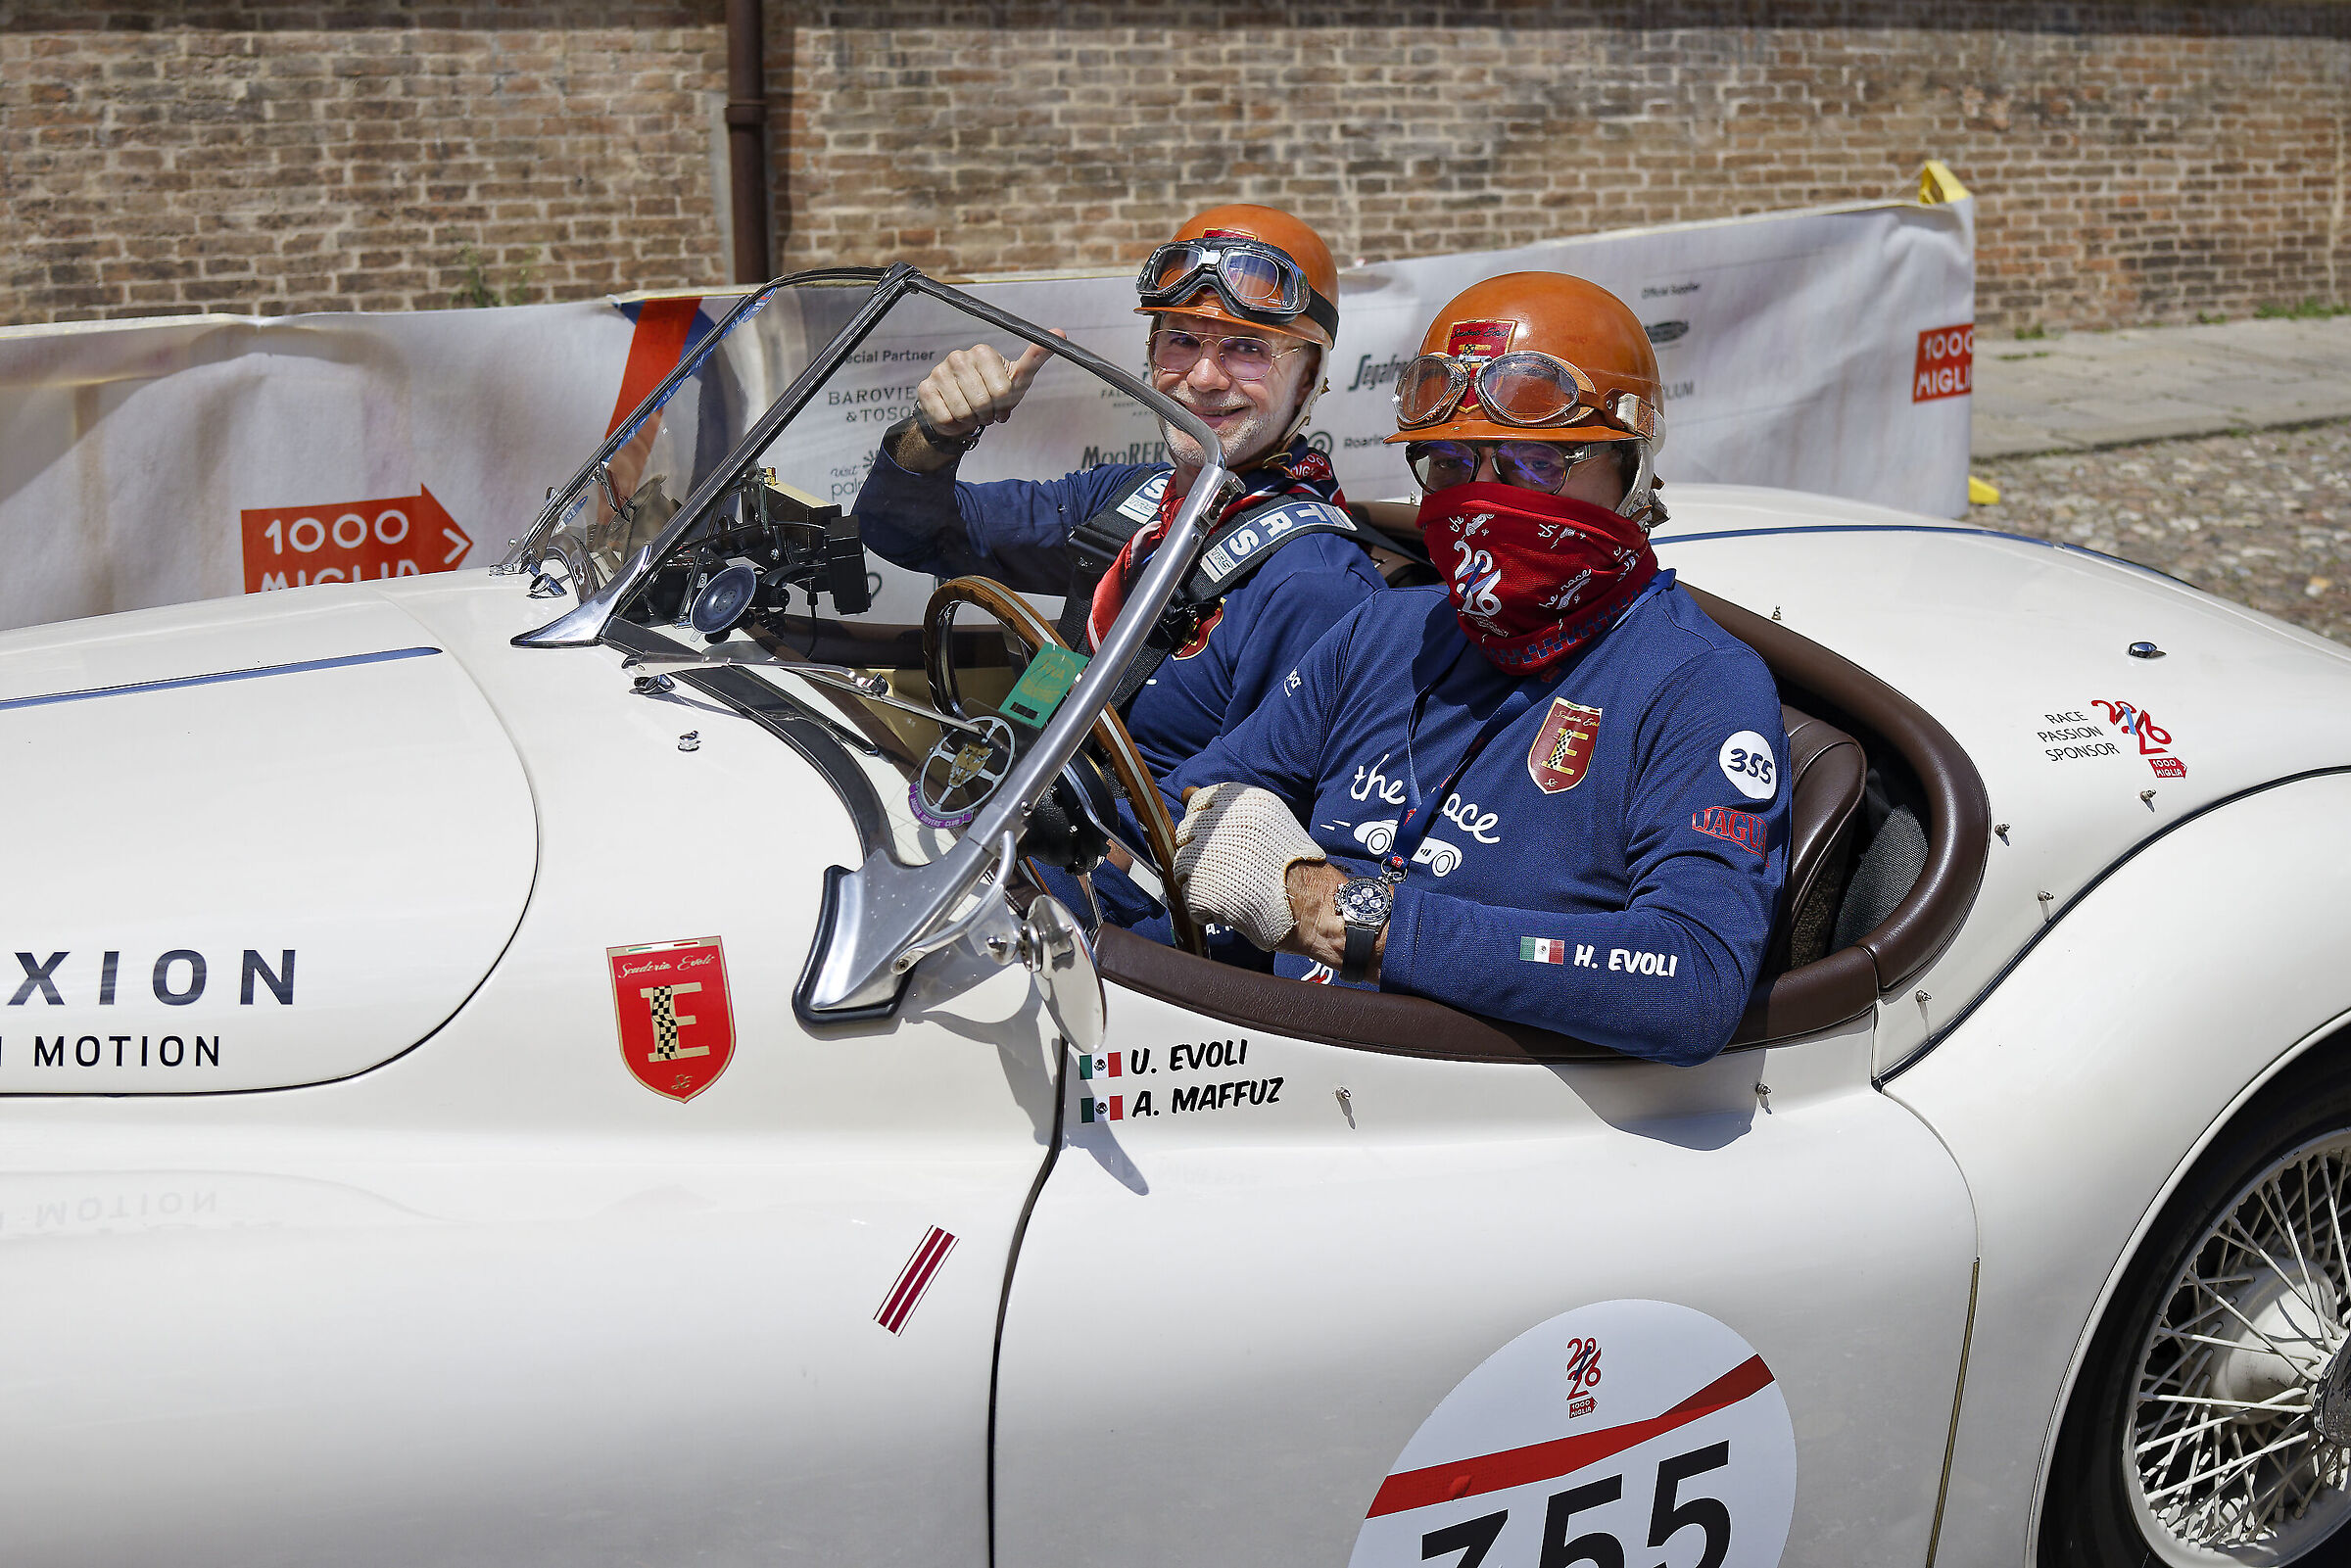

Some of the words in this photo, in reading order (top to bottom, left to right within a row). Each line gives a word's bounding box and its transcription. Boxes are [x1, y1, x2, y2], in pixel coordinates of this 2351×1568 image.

[845, 351, 878, 364] ecial
[882, 350, 936, 362] Partner
[1916, 365, 1972, 397] MIGLI
[828, 386, 918, 405] BAROVIE
[831, 477, 864, 501] pal
[264, 509, 409, 555] 1000
[2044, 711, 2089, 725] RACE
[2037, 726, 2104, 743] PASSION
[2045, 742, 2121, 762] SPONSOR
[2152, 759, 2177, 768] 1000
[1727, 748, 1773, 784] 355
[1350, 754, 1407, 805] the
[1434, 792, 1501, 844] ace
[1697, 809, 1764, 851] JAGU
[677, 954, 715, 972] Evoli
[1573, 943, 1599, 970] H.
[1607, 948, 1678, 977] EVOLI
[33, 1035, 219, 1068] MOTION
[1130, 1047, 1158, 1075] U.
[1169, 1038, 1249, 1072] EVOLI
[1131, 1090, 1161, 1118] A.
[1171, 1076, 1285, 1115] MAFFUZ
[1570, 1406, 1593, 1418] MIGLIA
[1571, 1400, 1591, 1410] 1000
